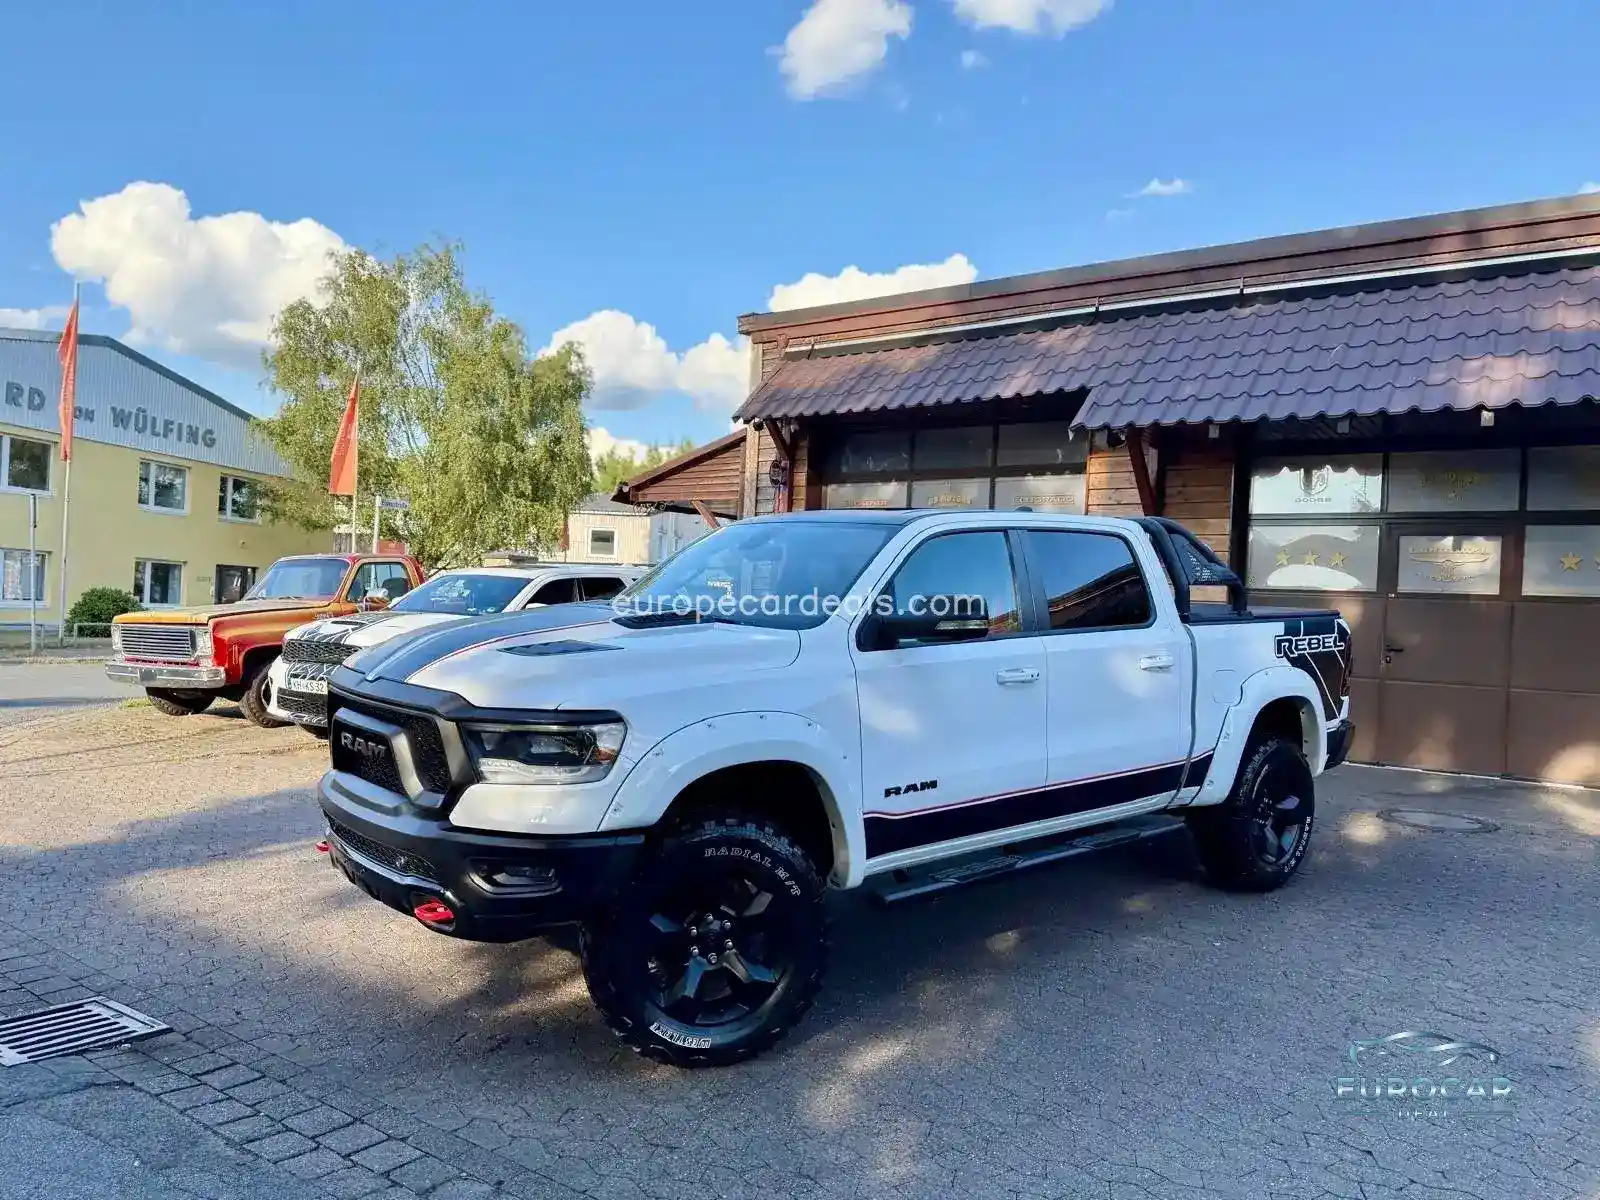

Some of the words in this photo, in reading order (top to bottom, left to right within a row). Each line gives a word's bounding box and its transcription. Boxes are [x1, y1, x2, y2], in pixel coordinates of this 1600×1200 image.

[74, 406, 95, 423] ON
[110, 405, 217, 448] WÜLFING
[1274, 633, 1345, 657] REBEL
[341, 731, 388, 759] RAM
[884, 779, 938, 798] RAM
[704, 846, 772, 868] RADIAL
[774, 866, 801, 897] M/T
[649, 1022, 712, 1049] WESTLAKE
